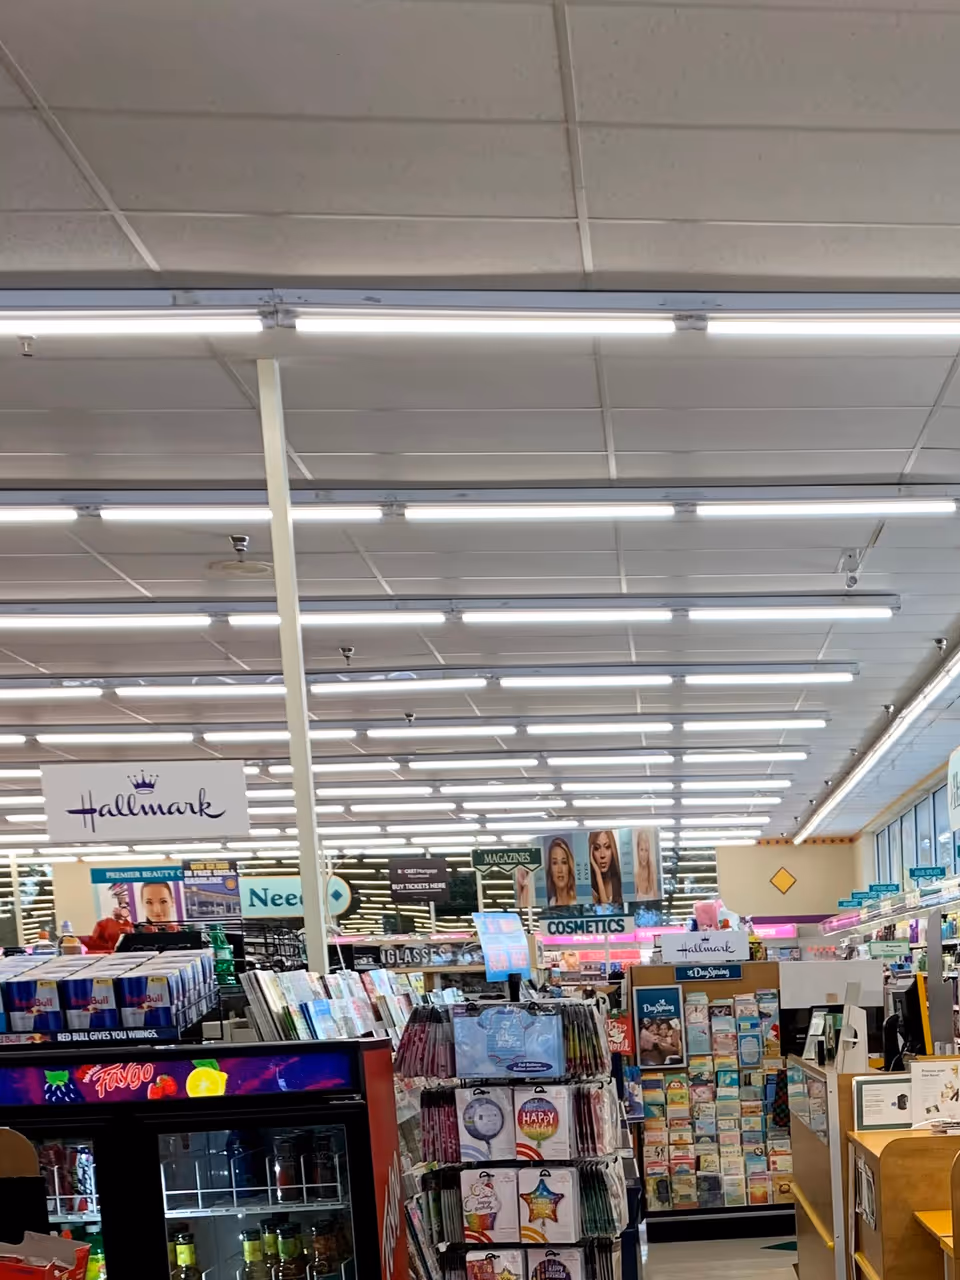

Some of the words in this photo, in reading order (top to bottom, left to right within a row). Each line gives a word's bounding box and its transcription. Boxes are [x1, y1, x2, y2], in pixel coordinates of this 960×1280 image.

[65, 787, 226, 833] Hallmark
[483, 852, 530, 864] MAGAZINES
[106, 871, 140, 879] PREMIER
[142, 870, 175, 878] BEAUTY
[392, 883, 405, 891] BUY
[249, 886, 304, 908] Nee
[547, 919, 625, 936] COSMETICS
[676, 940, 736, 960] Hallmark
[694, 967, 730, 979] DaySpring
[643, 1002, 675, 1014] DaySpring
[57, 1030, 70, 1041] RED
[72, 1030, 88, 1041] BULL
[89, 1030, 110, 1040] GIVES
[111, 1030, 126, 1040] YOU
[95, 1062, 155, 1098] Faygo
[523, 1112, 554, 1124] HAPPY
